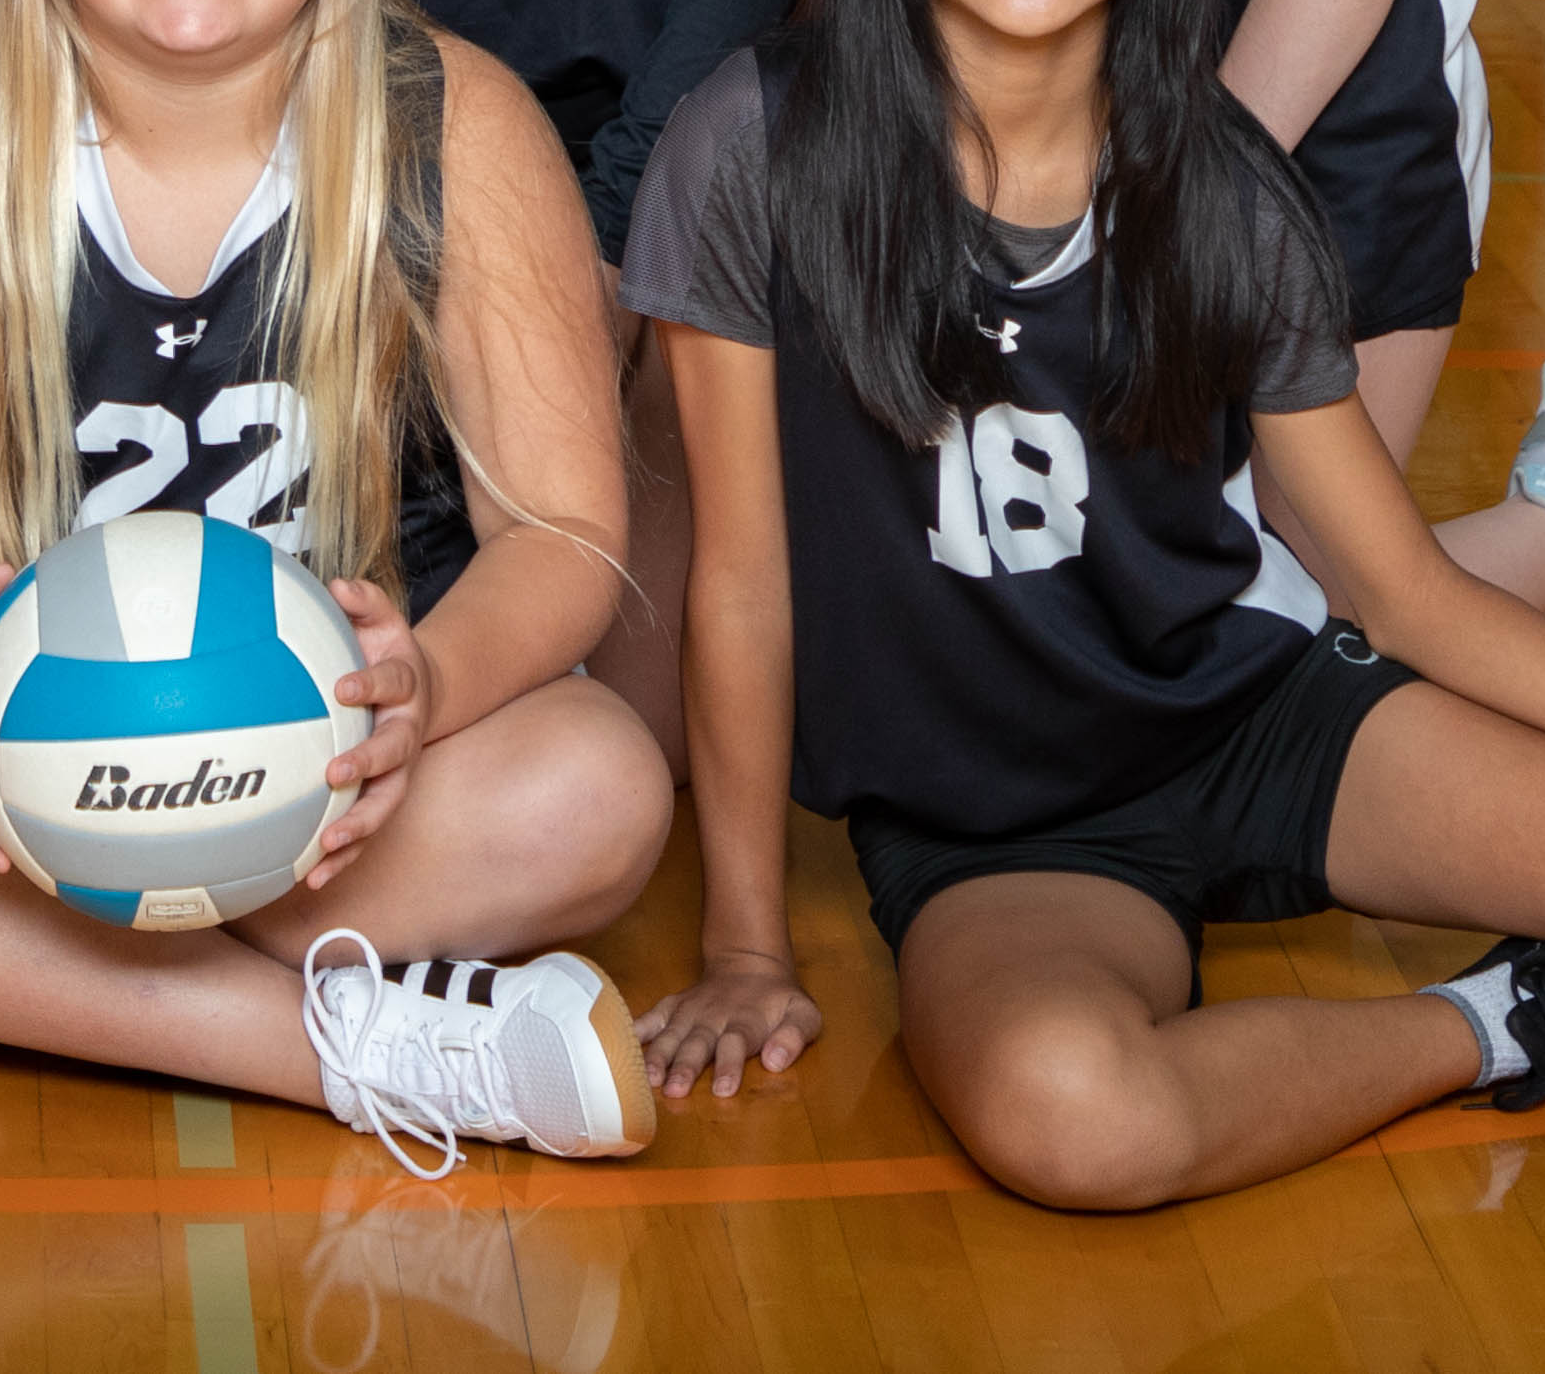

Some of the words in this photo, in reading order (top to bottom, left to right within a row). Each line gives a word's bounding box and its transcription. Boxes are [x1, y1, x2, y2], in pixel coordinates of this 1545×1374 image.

[71, 381, 311, 552] 22
[926, 403, 1090, 578] 18
[75, 758, 268, 811] Baden
